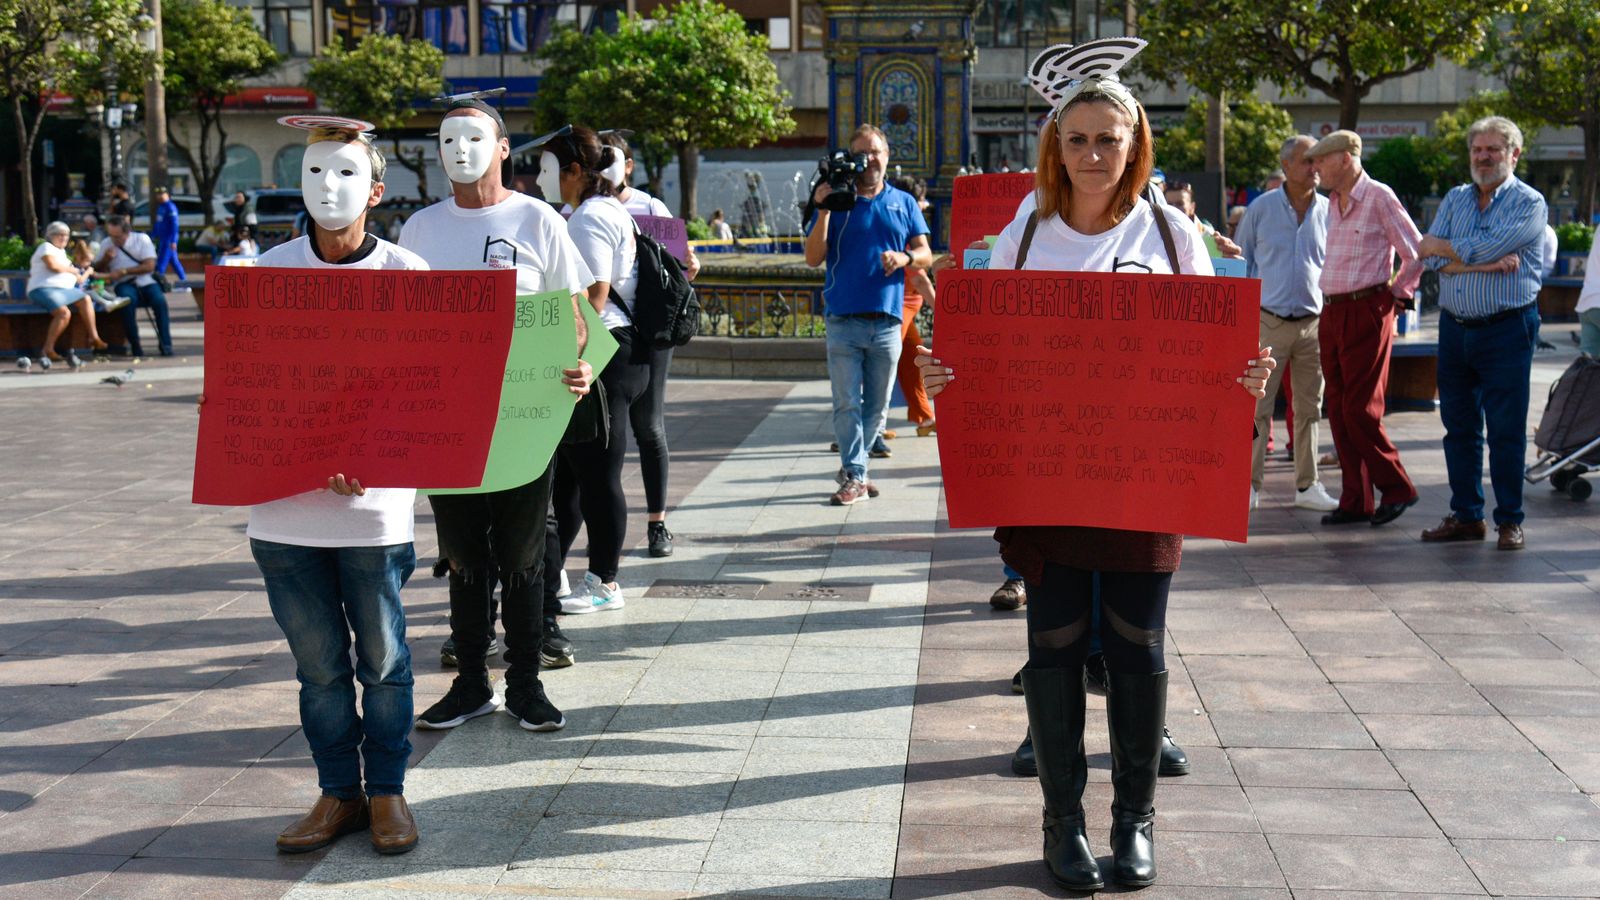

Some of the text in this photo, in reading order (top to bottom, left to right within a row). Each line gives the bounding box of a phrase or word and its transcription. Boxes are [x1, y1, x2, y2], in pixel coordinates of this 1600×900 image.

[213, 271, 496, 313] SIN COBERTURA EN VIVIENDA
[942, 277, 1237, 327] CON COBERTURA EN VIVIENDA
[514, 297, 560, 328] ES DE
[354, 328, 389, 343] ACTOS
[459, 330, 473, 344] EN
[478, 330, 494, 344] LA
[960, 330, 1000, 347] TENGO
[1011, 333, 1030, 347] UN
[1043, 333, 1084, 351] HOGAR
[1119, 335, 1143, 352] QUE
[1158, 338, 1205, 357] VOLVER
[225, 340, 261, 354] CALLE
[288, 363, 302, 377] UN
[308, 362, 337, 379] LUGAR
[344, 365, 377, 379] DONDE
[505, 368, 537, 383] SCUCHE
[1007, 359, 1076, 377] PROTEGIDO
[1086, 361, 1104, 379] DE
[1112, 364, 1136, 380] LAS
[291, 378, 306, 392] EN
[962, 377, 985, 392] DEL
[961, 401, 1001, 417] TENGO
[1008, 403, 1025, 418] UN
[1031, 402, 1066, 418] LUGAR
[1077, 404, 1116, 421] DONDE
[1127, 406, 1200, 422] DESCANSAR
[1209, 407, 1218, 425] Y
[961, 417, 1104, 437] SENTIRME A SALVO
[250, 436, 284, 451] TENGO
[961, 443, 999, 459] TENGO
[1007, 444, 1024, 459] UN
[1032, 444, 1067, 459] LUGAR
[1075, 443, 1101, 460] QUE
[1104, 445, 1123, 463] ME
[1132, 446, 1149, 463] DA
[224, 450, 264, 467] TENGO
[975, 463, 1017, 478] DONDE
[1027, 462, 1064, 477] PUEDO
[1141, 466, 1156, 483] MI
[1166, 468, 1198, 486] VIDA
